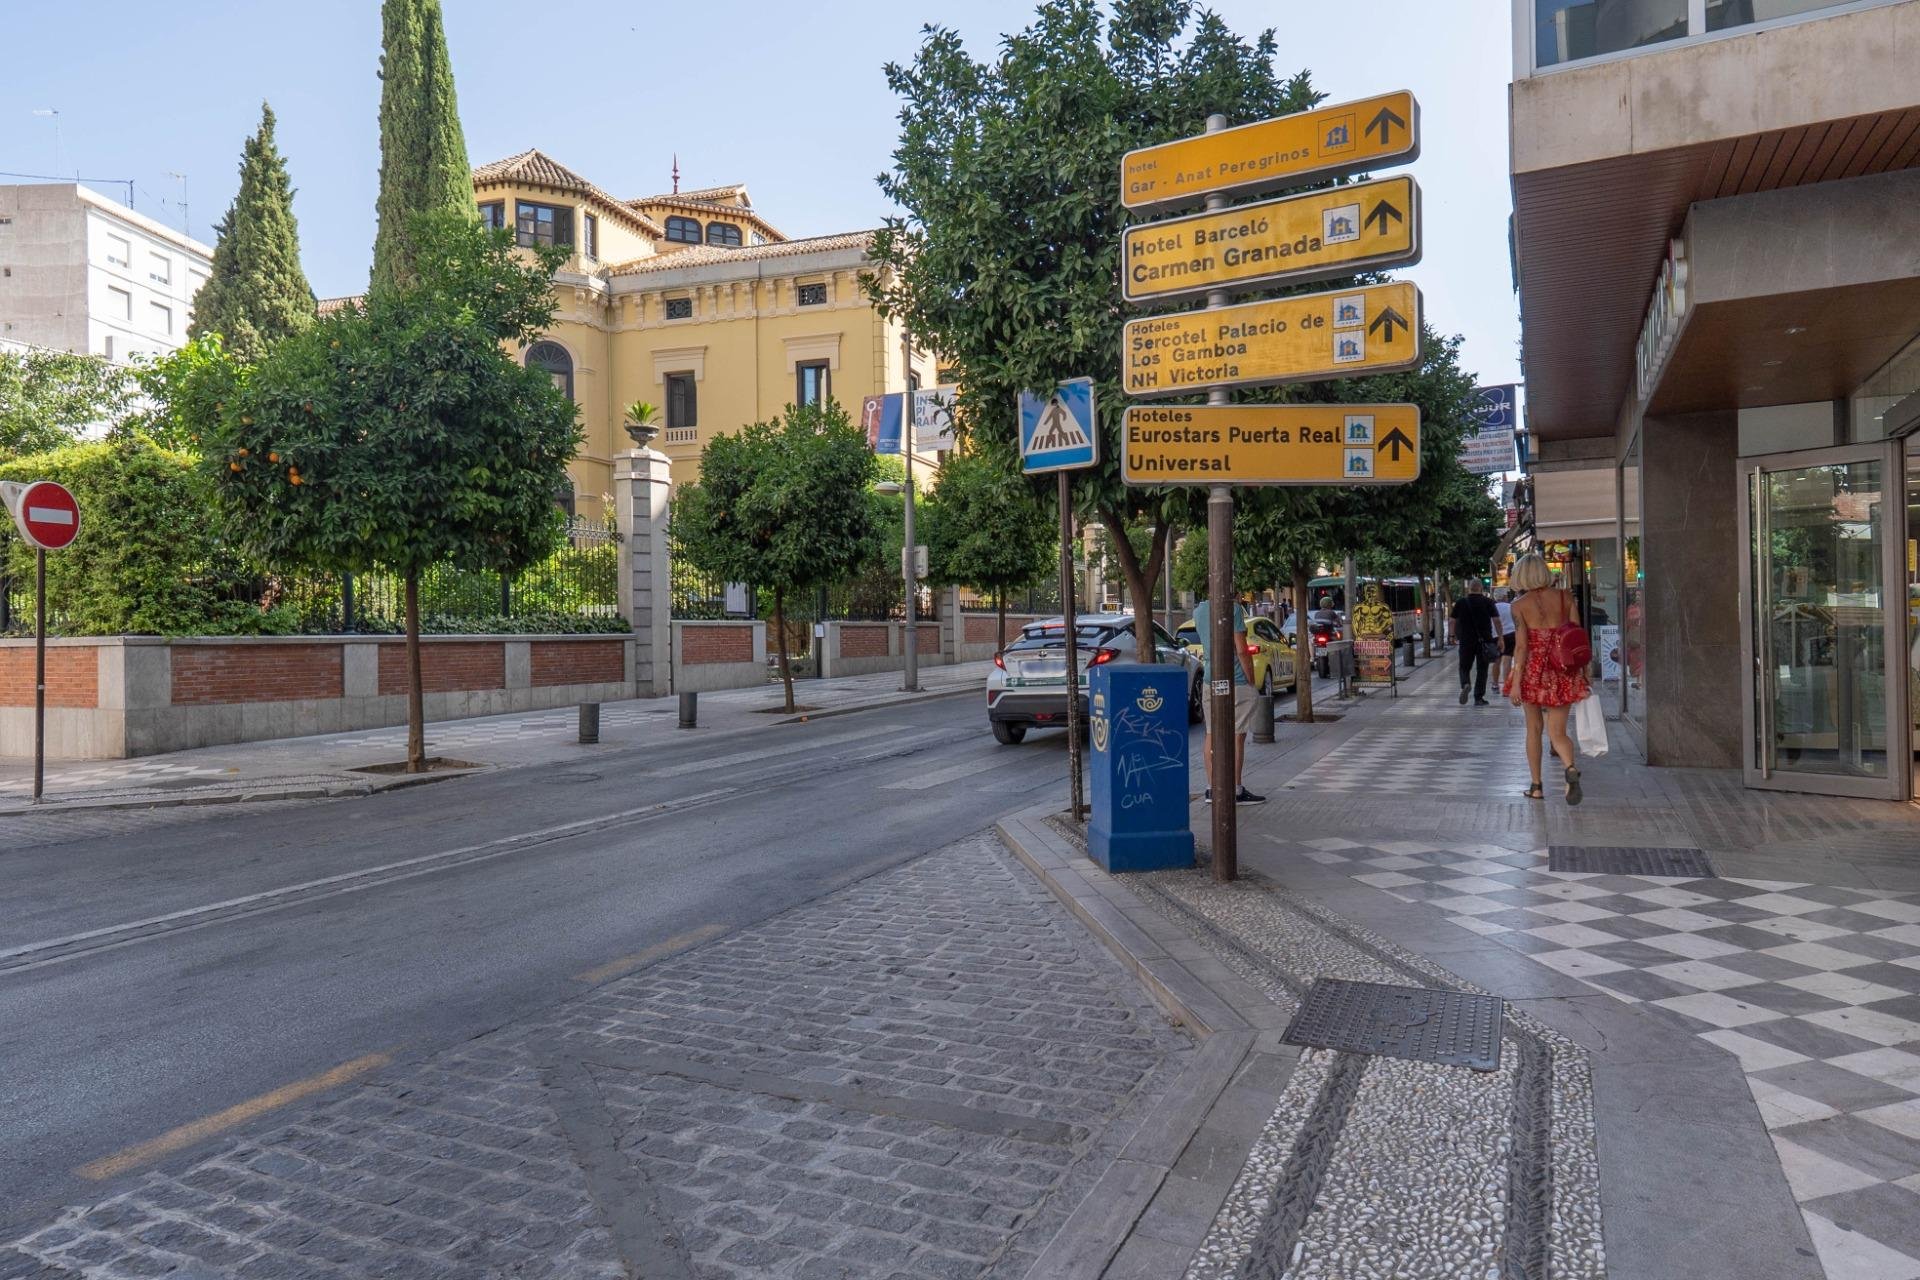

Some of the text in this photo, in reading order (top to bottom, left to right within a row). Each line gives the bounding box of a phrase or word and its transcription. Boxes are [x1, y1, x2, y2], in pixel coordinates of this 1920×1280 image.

[1128, 160, 1158, 174] hotel
[1130, 179, 1156, 194] Gar
[1175, 166, 1212, 185] Anat
[1219, 147, 1310, 176] Peregrinos
[1132, 217, 1269, 257] Hotel Barceló
[1132, 235, 1322, 283] Carmen Granada
[1131, 320, 1180, 335] Hoteles
[1132, 314, 1324, 351] Sercotel Palacio de
[1131, 342, 1247, 368] Los Gamboa
[1131, 363, 1239, 388] NH Victoria
[1129, 410, 1192, 423] Hoteles
[1129, 426, 1341, 444] Eurostars Puerta Real
[1129, 454, 1231, 471] Universal
